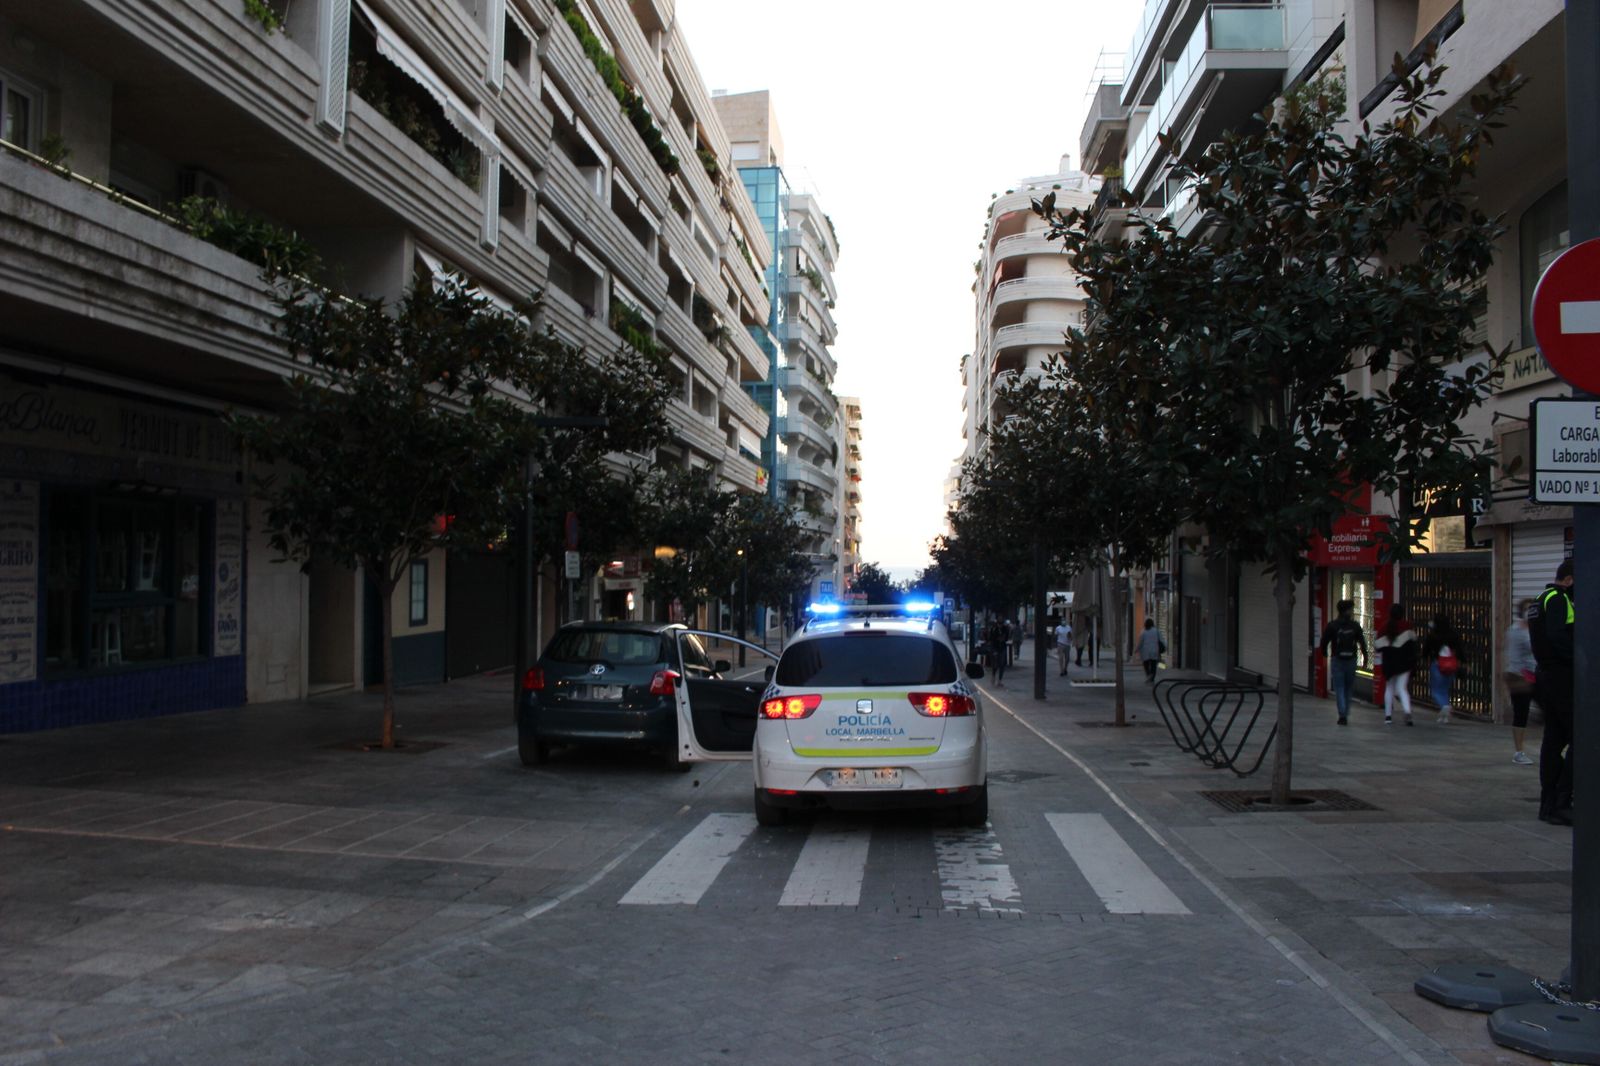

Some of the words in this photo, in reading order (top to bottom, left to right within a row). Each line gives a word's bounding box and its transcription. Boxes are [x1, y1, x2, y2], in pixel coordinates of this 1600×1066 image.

[1560, 426, 1600, 441] CARGA
[1539, 480, 1572, 495] VADO
[1328, 543, 1361, 554] Express
[838, 712, 892, 727] POLICÍA
[825, 727, 852, 736] LOCAL
[856, 727, 905, 736] MARBELLA
